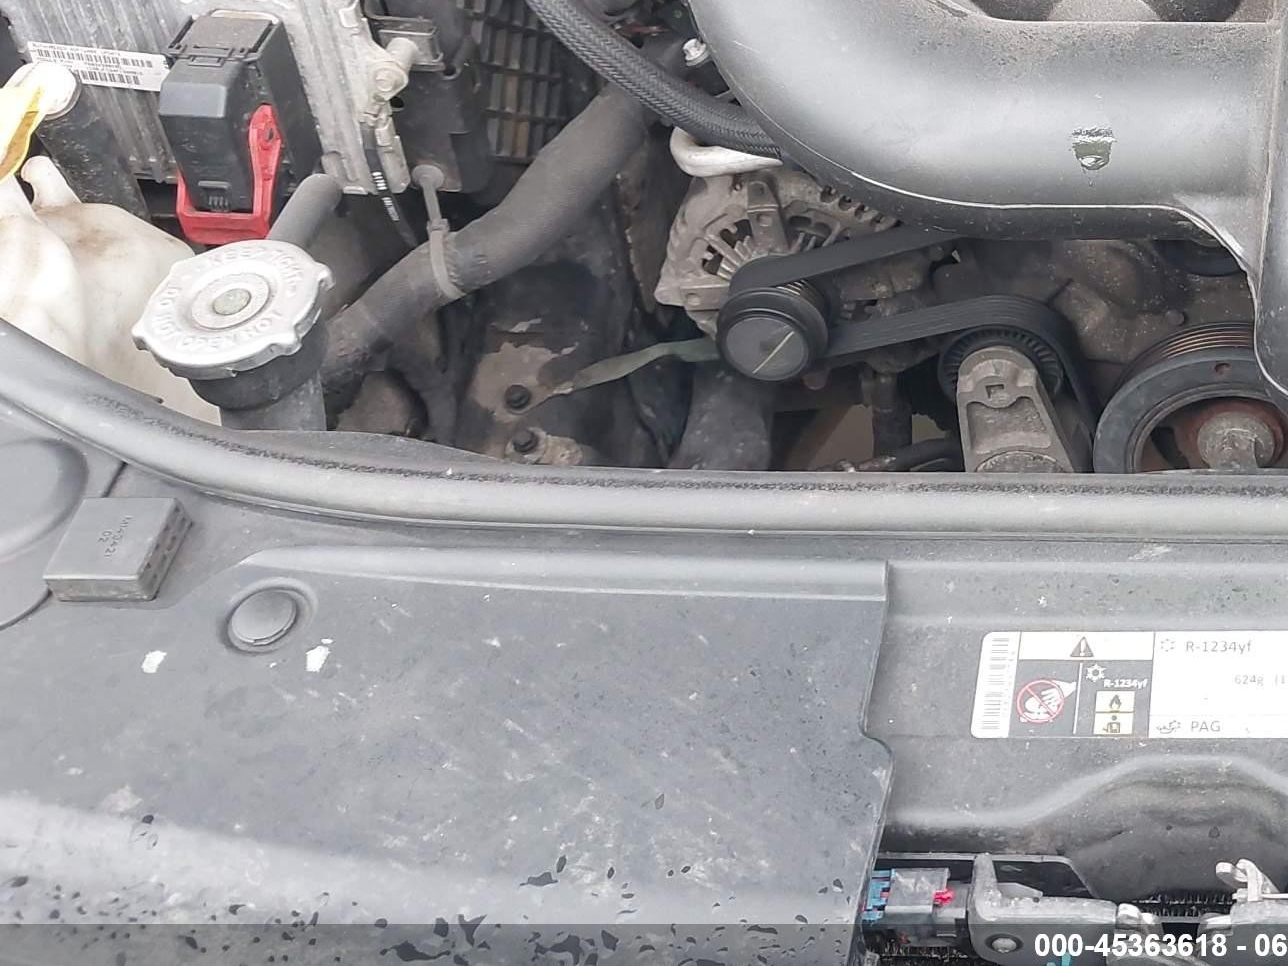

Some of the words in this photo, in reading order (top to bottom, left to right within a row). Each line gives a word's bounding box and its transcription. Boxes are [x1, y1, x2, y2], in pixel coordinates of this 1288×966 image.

[1185, 640, 1252, 655] R-1234yf
[1234, 674, 1264, 686] 624g
[1190, 720, 1221, 732] PAG
